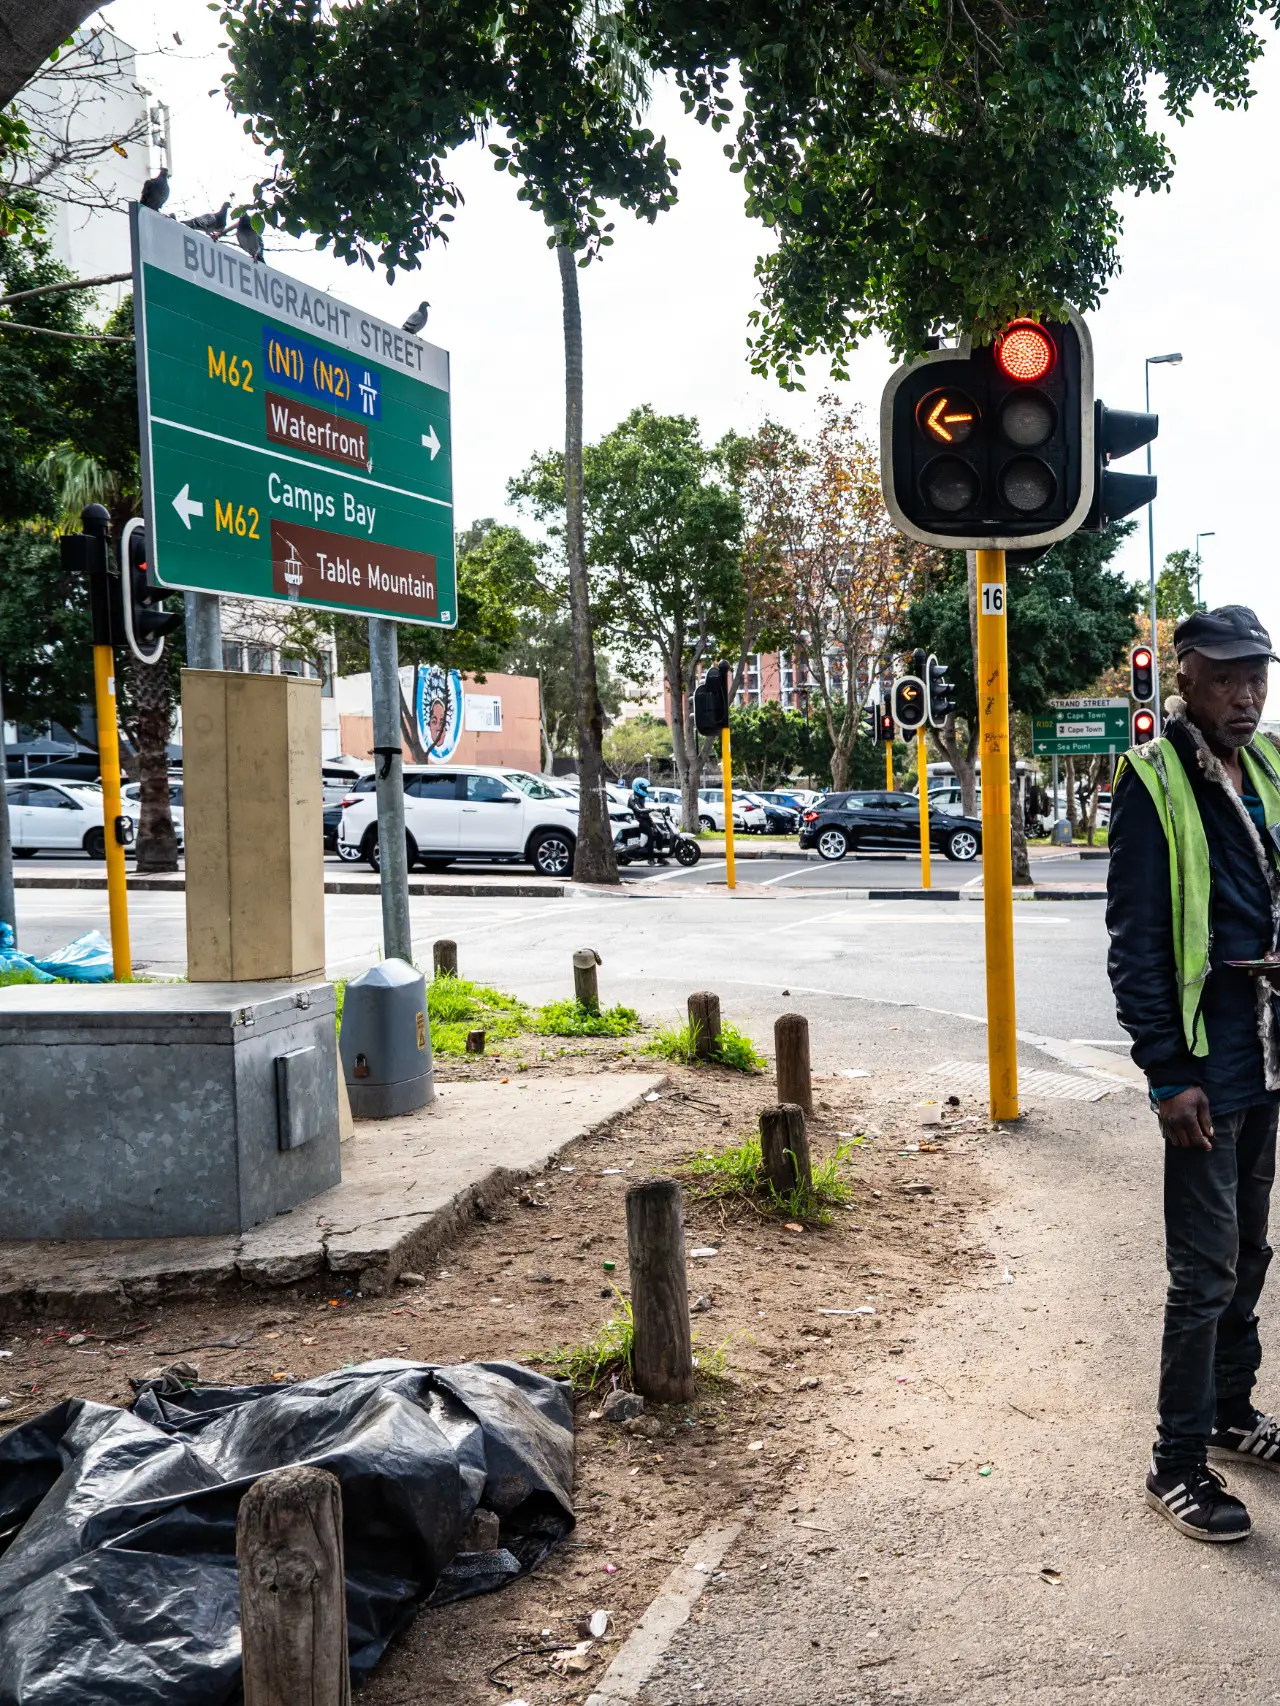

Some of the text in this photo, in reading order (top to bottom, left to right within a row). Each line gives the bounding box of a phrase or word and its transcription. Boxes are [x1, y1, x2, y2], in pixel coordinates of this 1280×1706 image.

[183, 234, 424, 371] BUITENGRACHT STREET
[207, 339, 350, 401] M62 (N1) (N2)
[270, 403, 365, 460] Waterfront
[215, 499, 260, 539] M62
[268, 472, 376, 534] Camps Bay
[316, 552, 434, 600] Table Mountain
[983, 588, 1003, 610] 16
[1066, 711, 1107, 720] Cape Town
[1067, 726, 1084, 734] Cape
